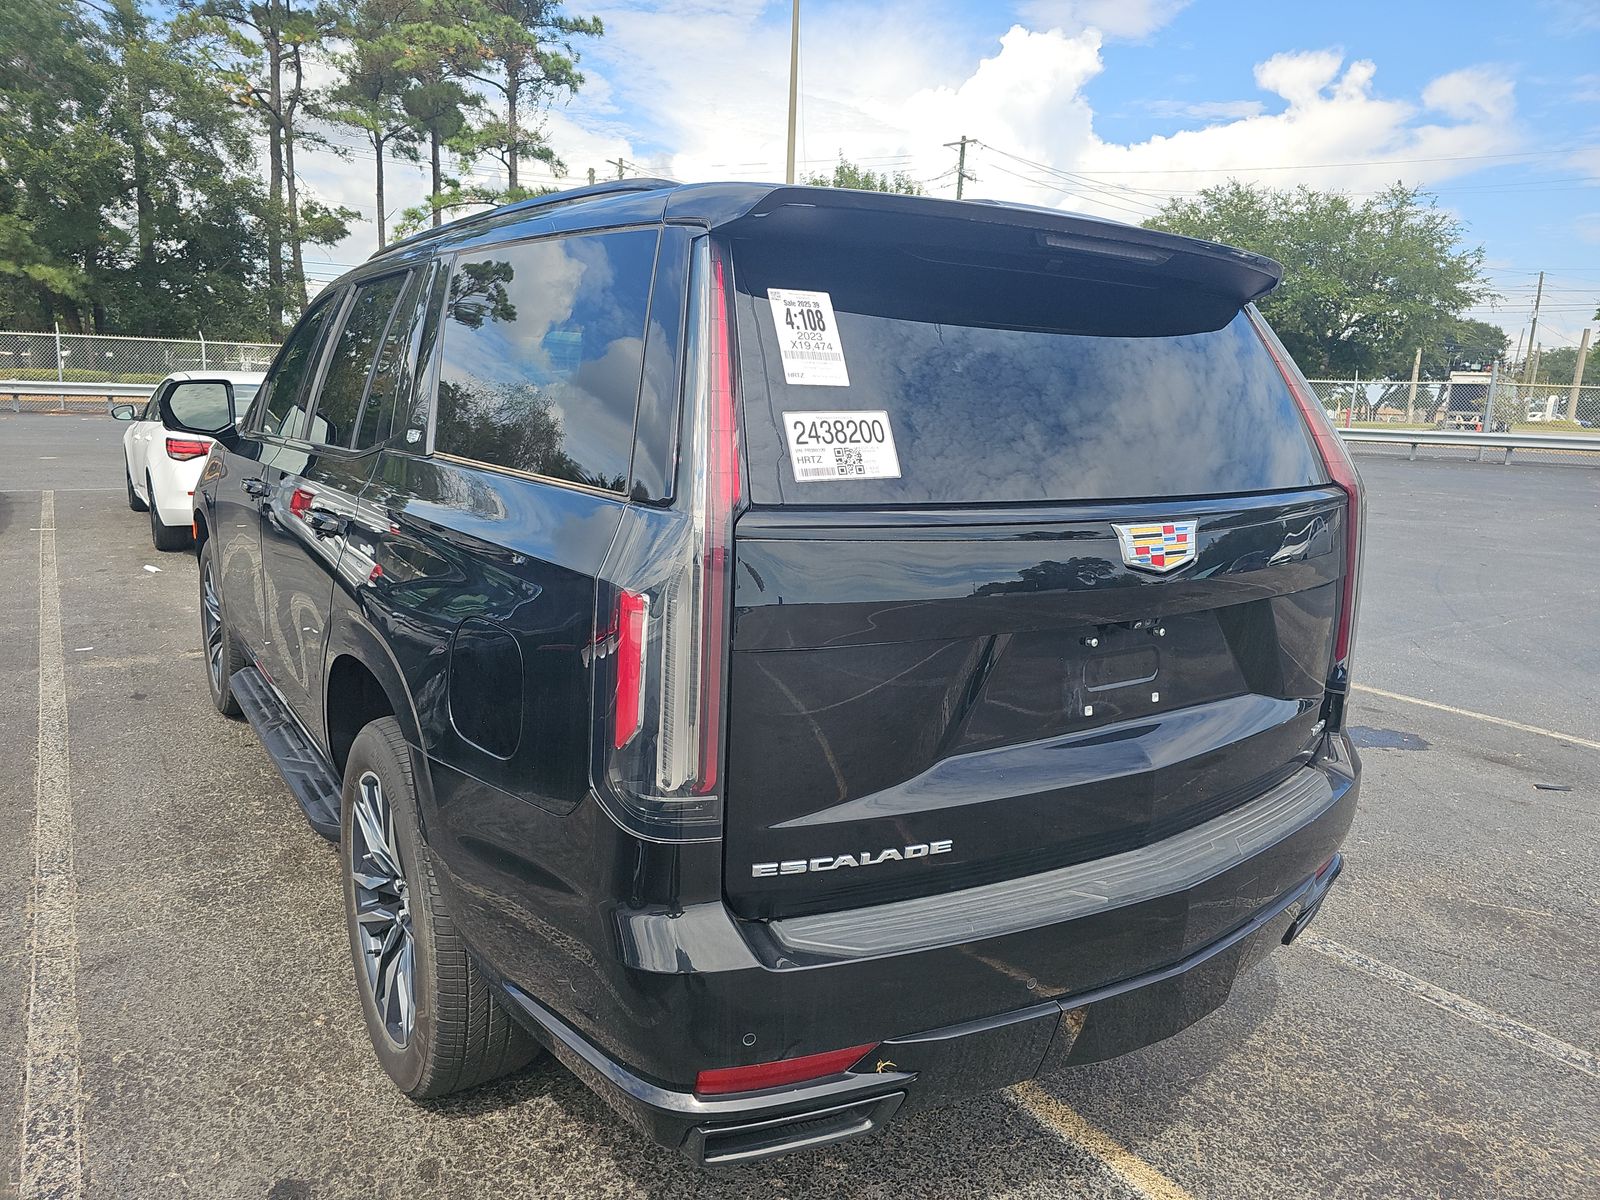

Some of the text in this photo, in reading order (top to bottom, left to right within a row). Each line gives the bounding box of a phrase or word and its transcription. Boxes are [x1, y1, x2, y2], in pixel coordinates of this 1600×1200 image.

[783, 299, 796, 307] Sale
[798, 300, 811, 308] 2025
[785, 307, 826, 332] 4:108
[796, 331, 823, 341] 2023
[790, 340, 833, 351] X19,474
[793, 419, 885, 444] 2438200
[797, 455, 823, 464] HRTZ
[751, 839, 953, 878] ESCALADE
